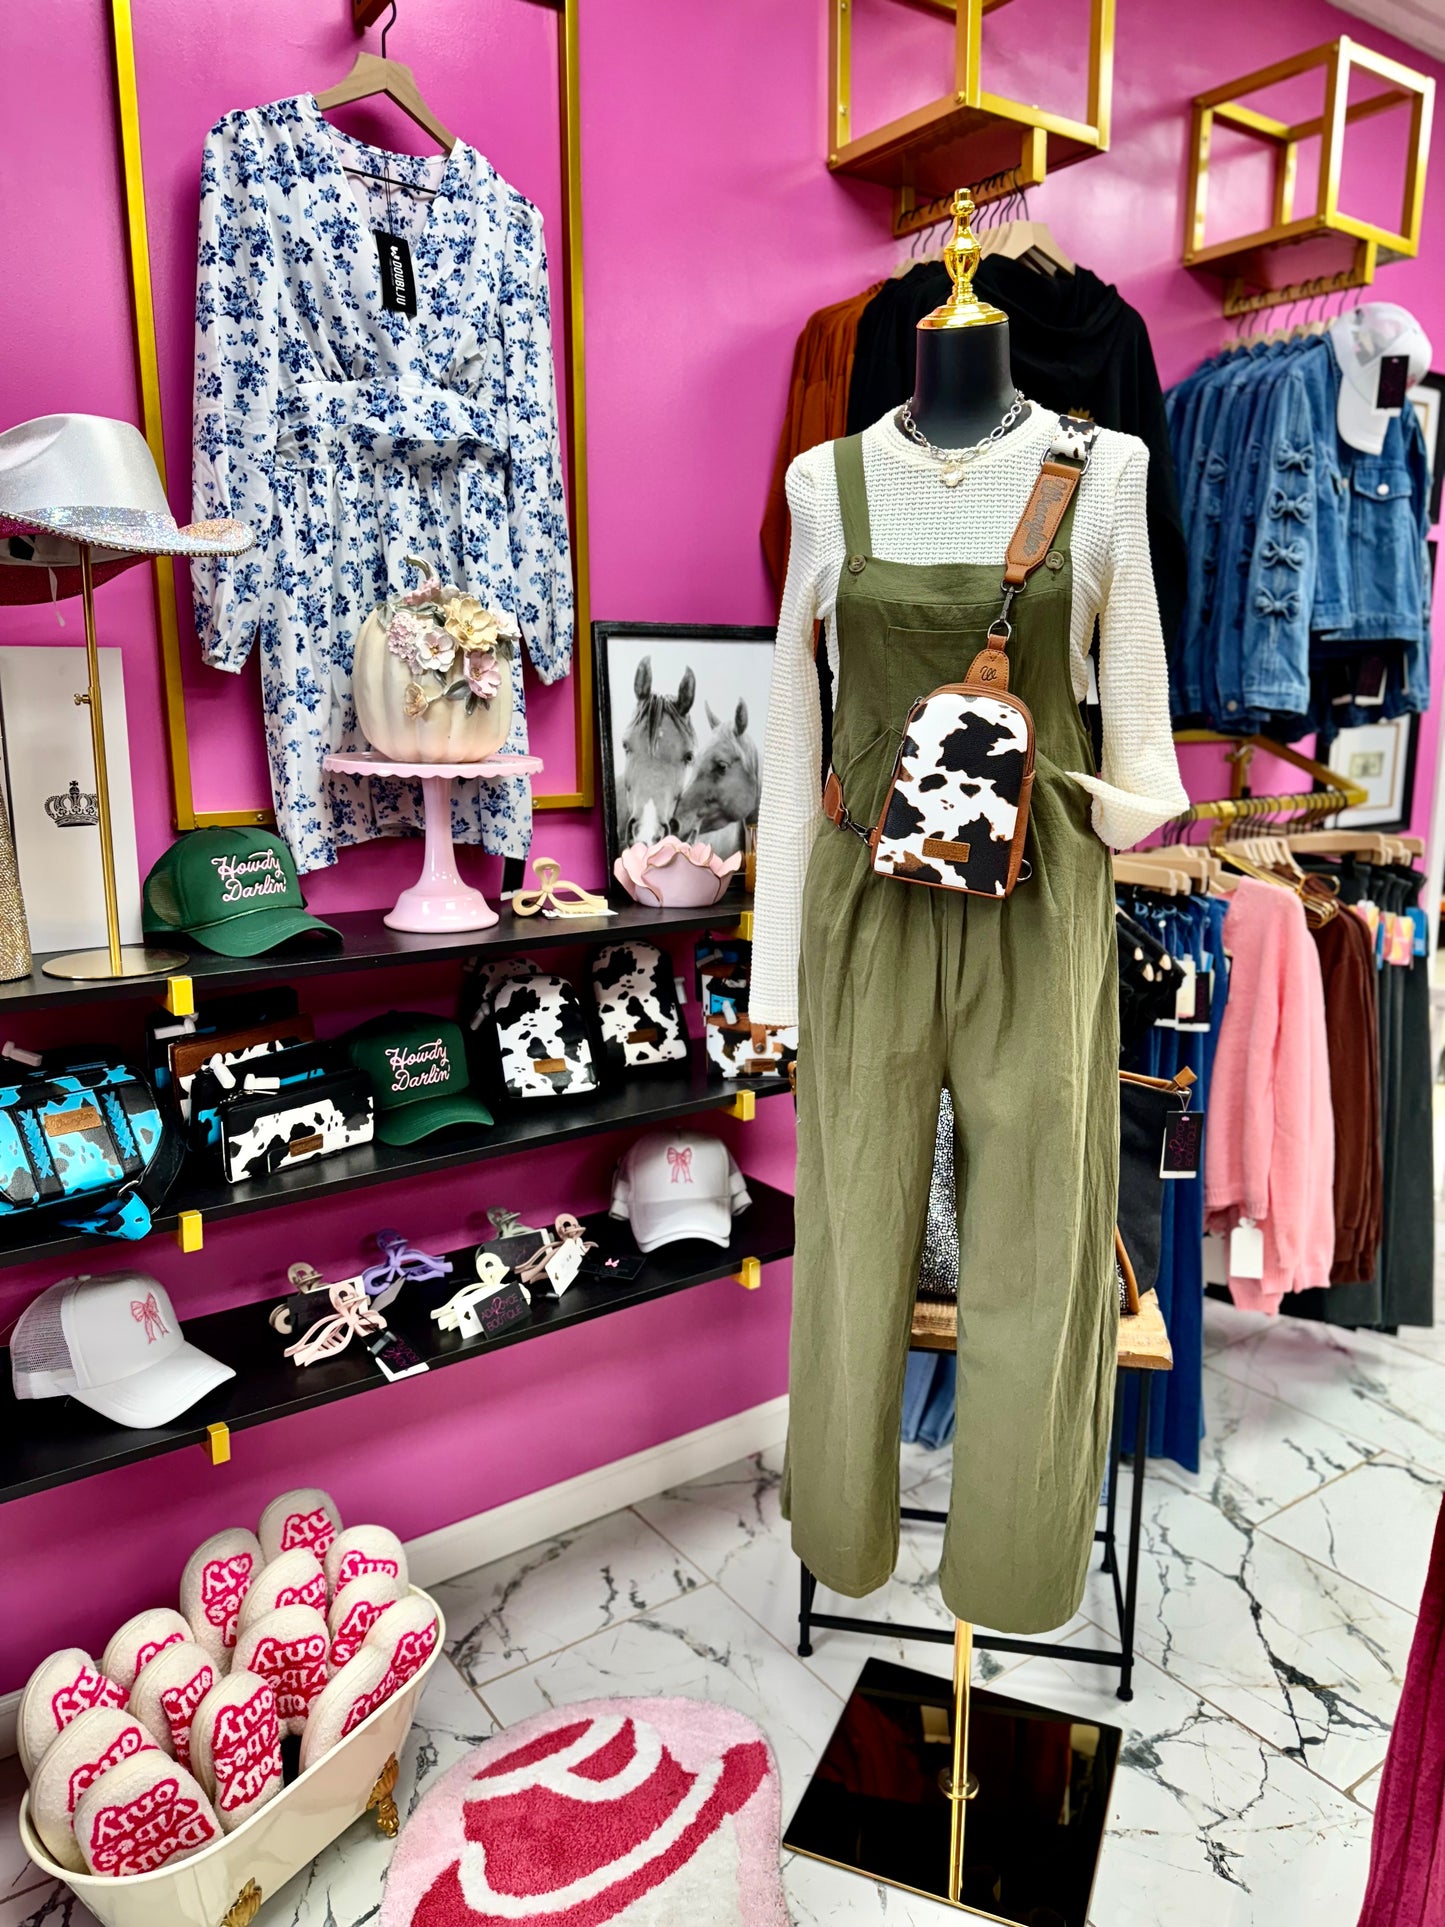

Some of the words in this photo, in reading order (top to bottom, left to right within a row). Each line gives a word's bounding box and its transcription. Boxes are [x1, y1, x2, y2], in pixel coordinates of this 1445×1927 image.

[393, 260, 406, 306] DOUBLJU
[211, 848, 285, 881] Howdy
[222, 874, 287, 902] Darlin'
[385, 1038, 450, 1071] Howdy
[391, 1063, 451, 1091] Darlin'
[486, 1304, 522, 1332] BOUTIQUE
